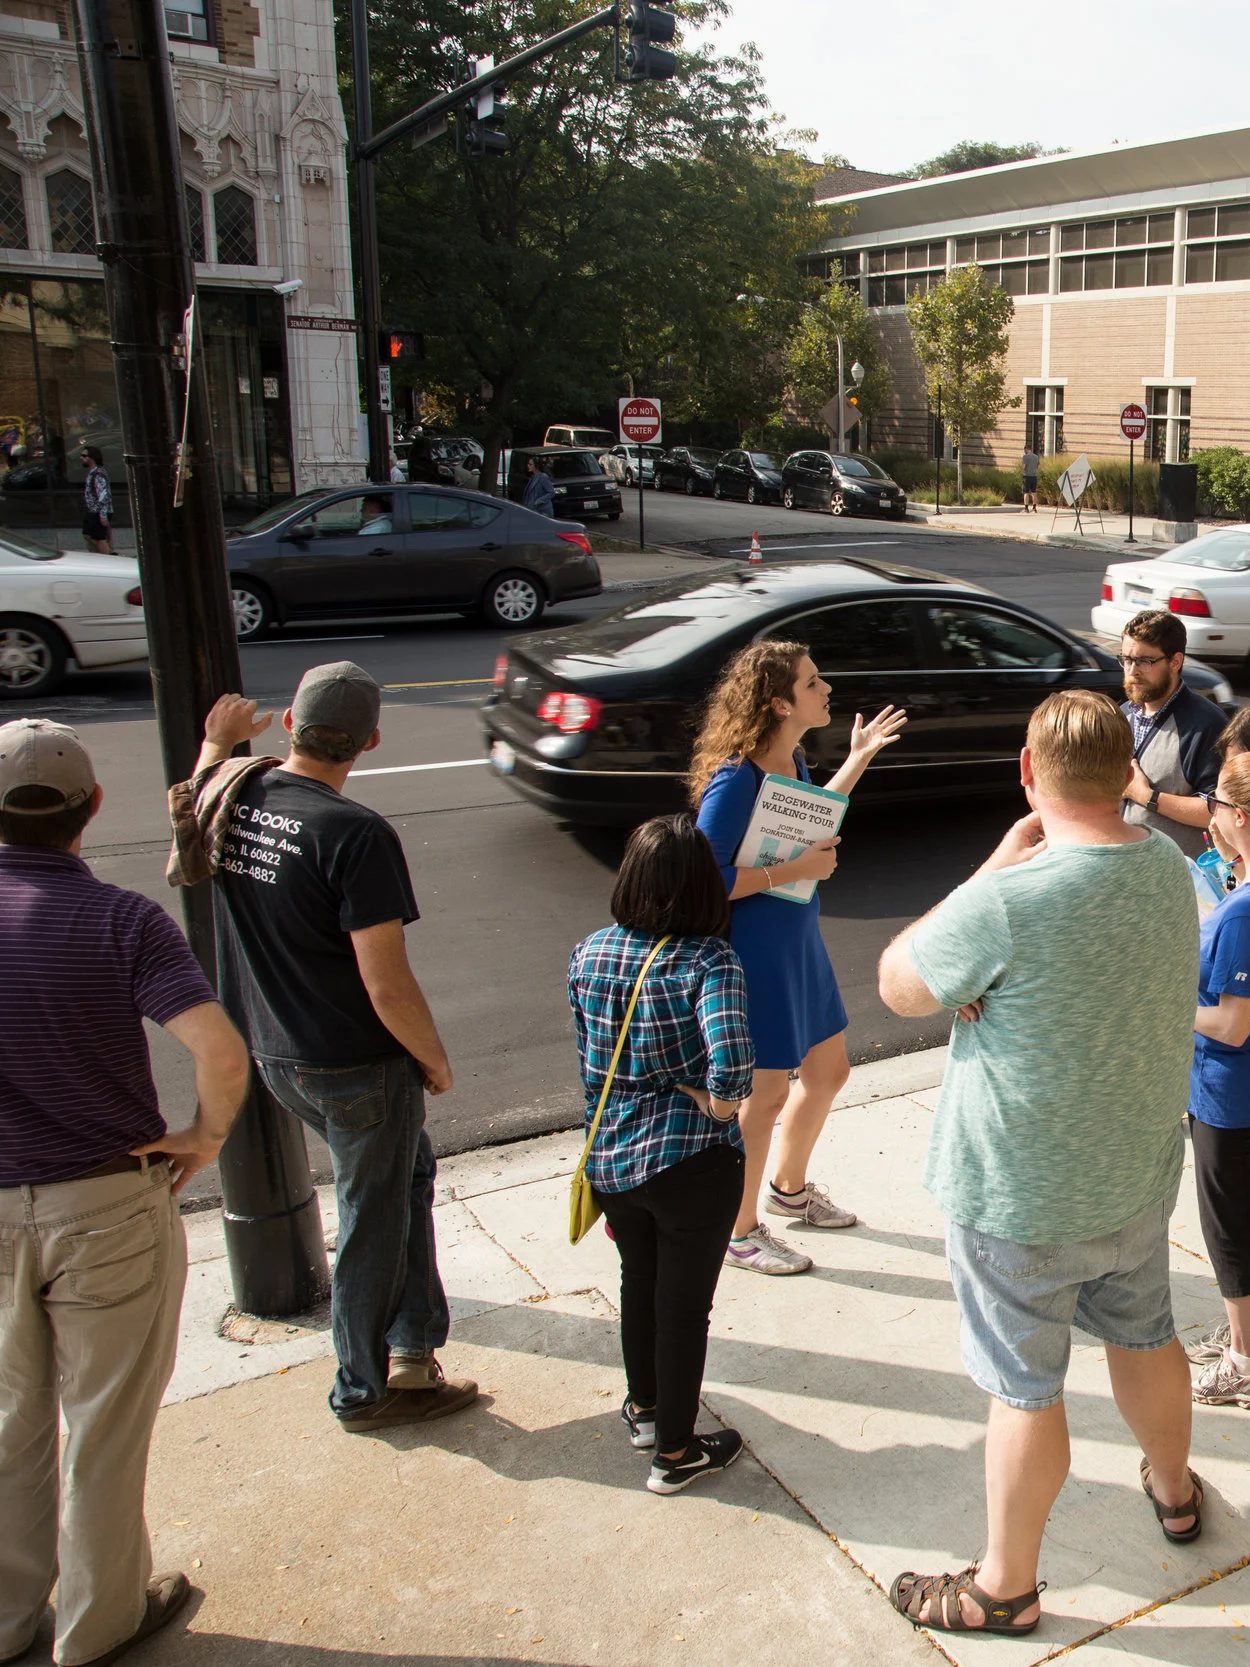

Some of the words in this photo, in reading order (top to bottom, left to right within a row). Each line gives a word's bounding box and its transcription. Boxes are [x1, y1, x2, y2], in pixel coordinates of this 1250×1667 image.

[312, 321, 330, 330] ARTHUR
[627, 407, 638, 415] DO
[640, 407, 654, 415] NOT
[629, 426, 653, 434] ENTER
[771, 791, 833, 816] EDGEWATER
[250, 808, 303, 835] BOOKS
[761, 800, 807, 820] WALKING
[809, 814, 835, 829] TOUR
[760, 826, 816, 846] DONATION-BASE
[777, 823, 794, 832] JOIN
[227, 823, 276, 847] Milwaukee
[277, 838, 303, 856] Ave.
[240, 844, 249, 856] IL
[250, 847, 281, 866] 60622
